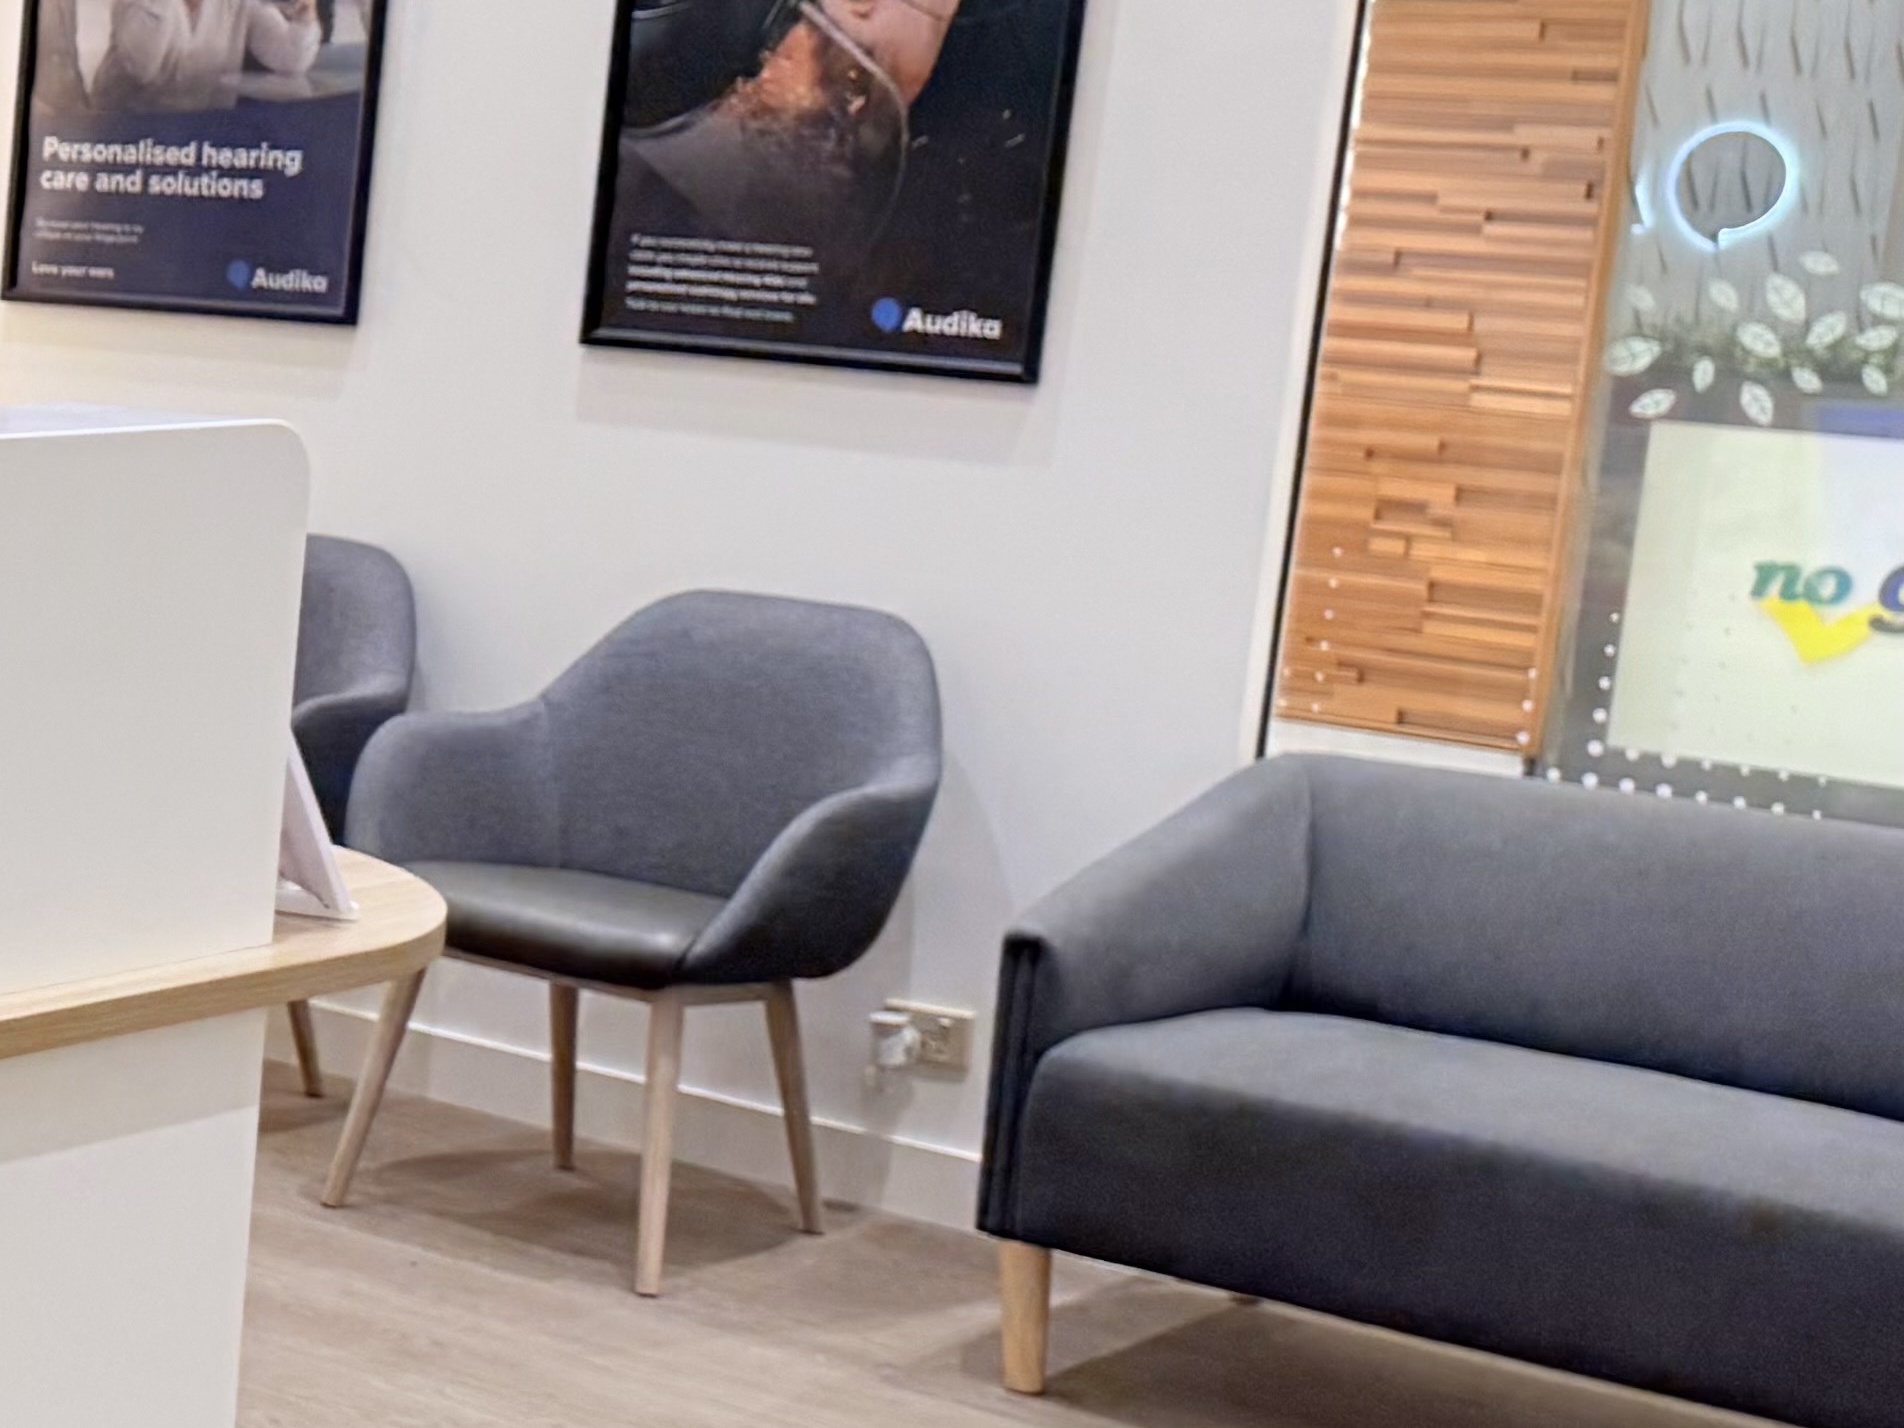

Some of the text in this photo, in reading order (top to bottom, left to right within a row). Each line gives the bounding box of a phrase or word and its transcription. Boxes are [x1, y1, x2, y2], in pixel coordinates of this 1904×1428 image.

[42, 135, 303, 177] Personalised hearing
[40, 168, 264, 200] care and solutions
[251, 268, 329, 294] Audika
[901, 307, 1003, 341] Audika
[1749, 559, 1853, 607] no
